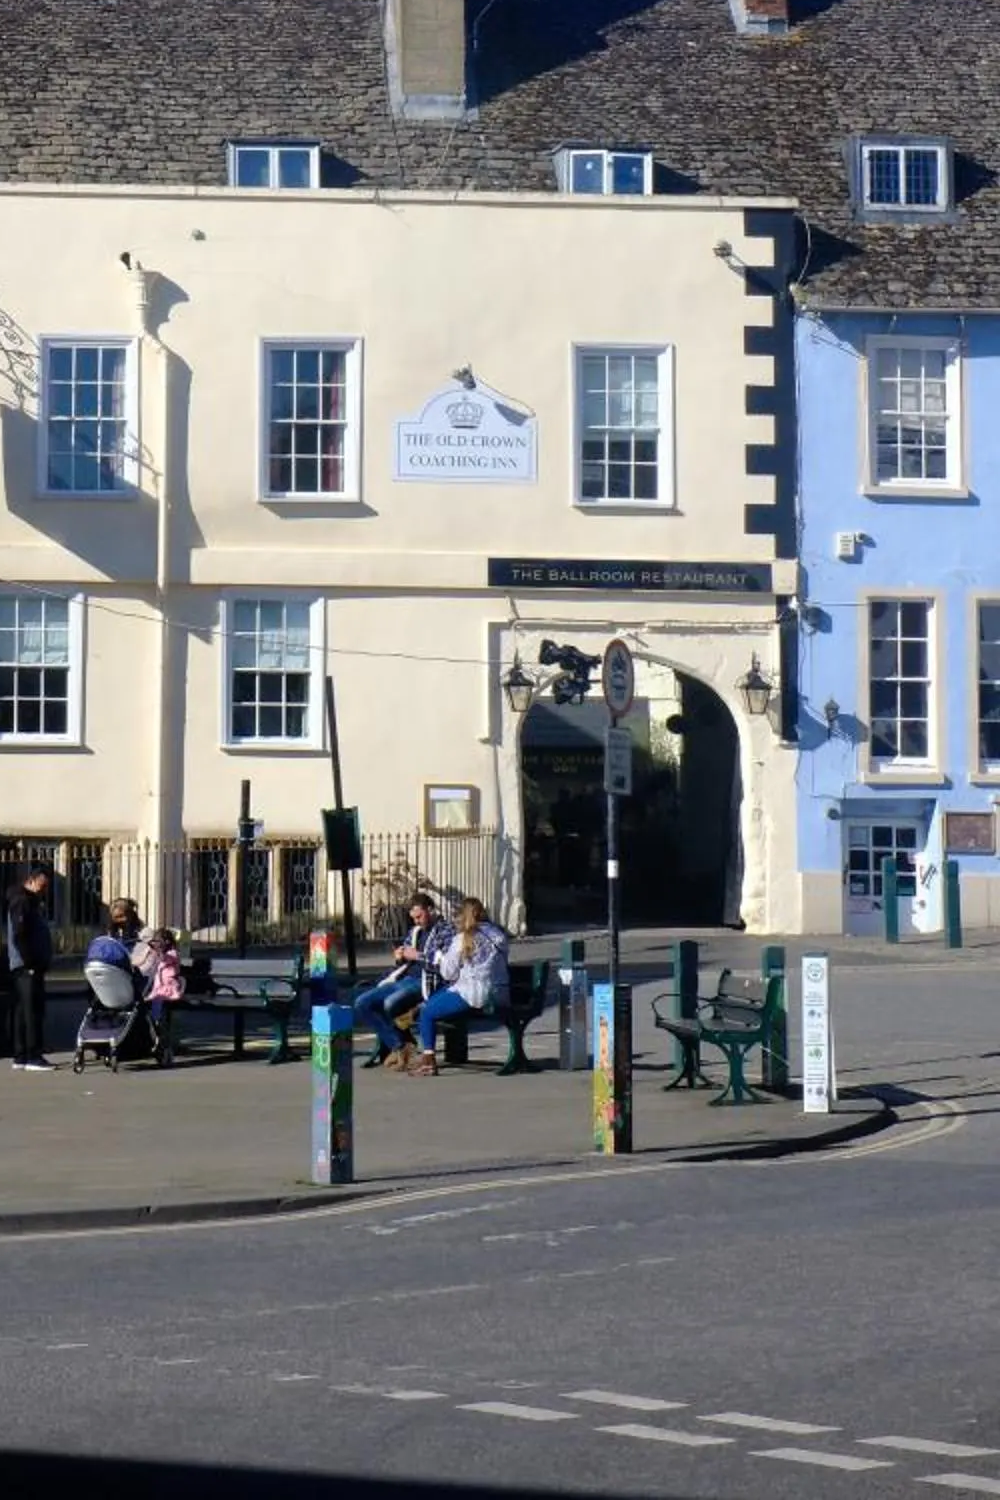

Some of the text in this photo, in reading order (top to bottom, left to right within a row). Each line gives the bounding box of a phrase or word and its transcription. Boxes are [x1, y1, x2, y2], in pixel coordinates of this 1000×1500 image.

[403, 432, 527, 449] THE OLD CROWN
[408, 453, 518, 469] COACHING INN
[511, 569, 748, 585] THE BALLROOM RESTAURANT
